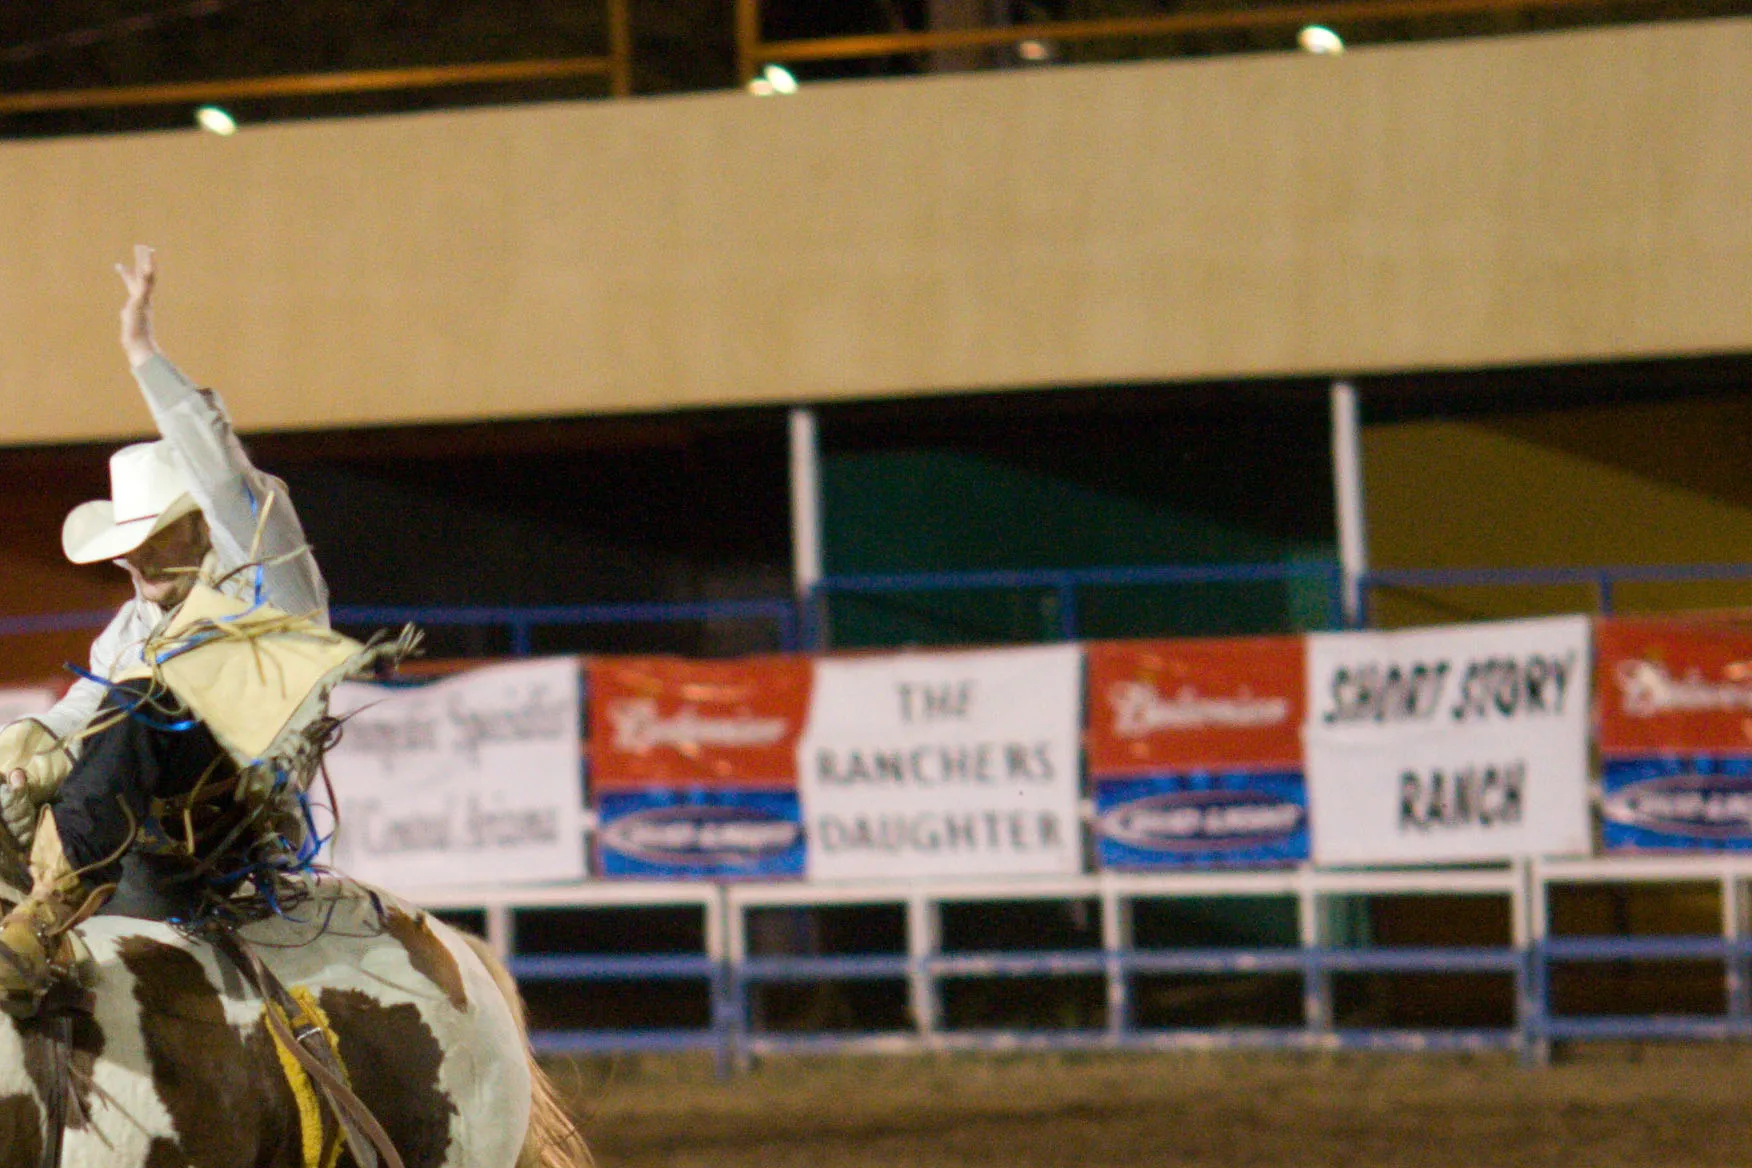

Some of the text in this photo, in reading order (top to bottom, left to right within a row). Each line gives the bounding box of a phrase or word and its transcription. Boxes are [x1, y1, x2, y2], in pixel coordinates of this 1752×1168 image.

[897, 677, 978, 724] THE
[1323, 658, 1451, 725] SHORT
[1452, 649, 1576, 721] STORY
[815, 740, 1055, 786] RANCHERS
[1398, 757, 1526, 832] RANCH
[817, 808, 1062, 854] DAUGHTER
